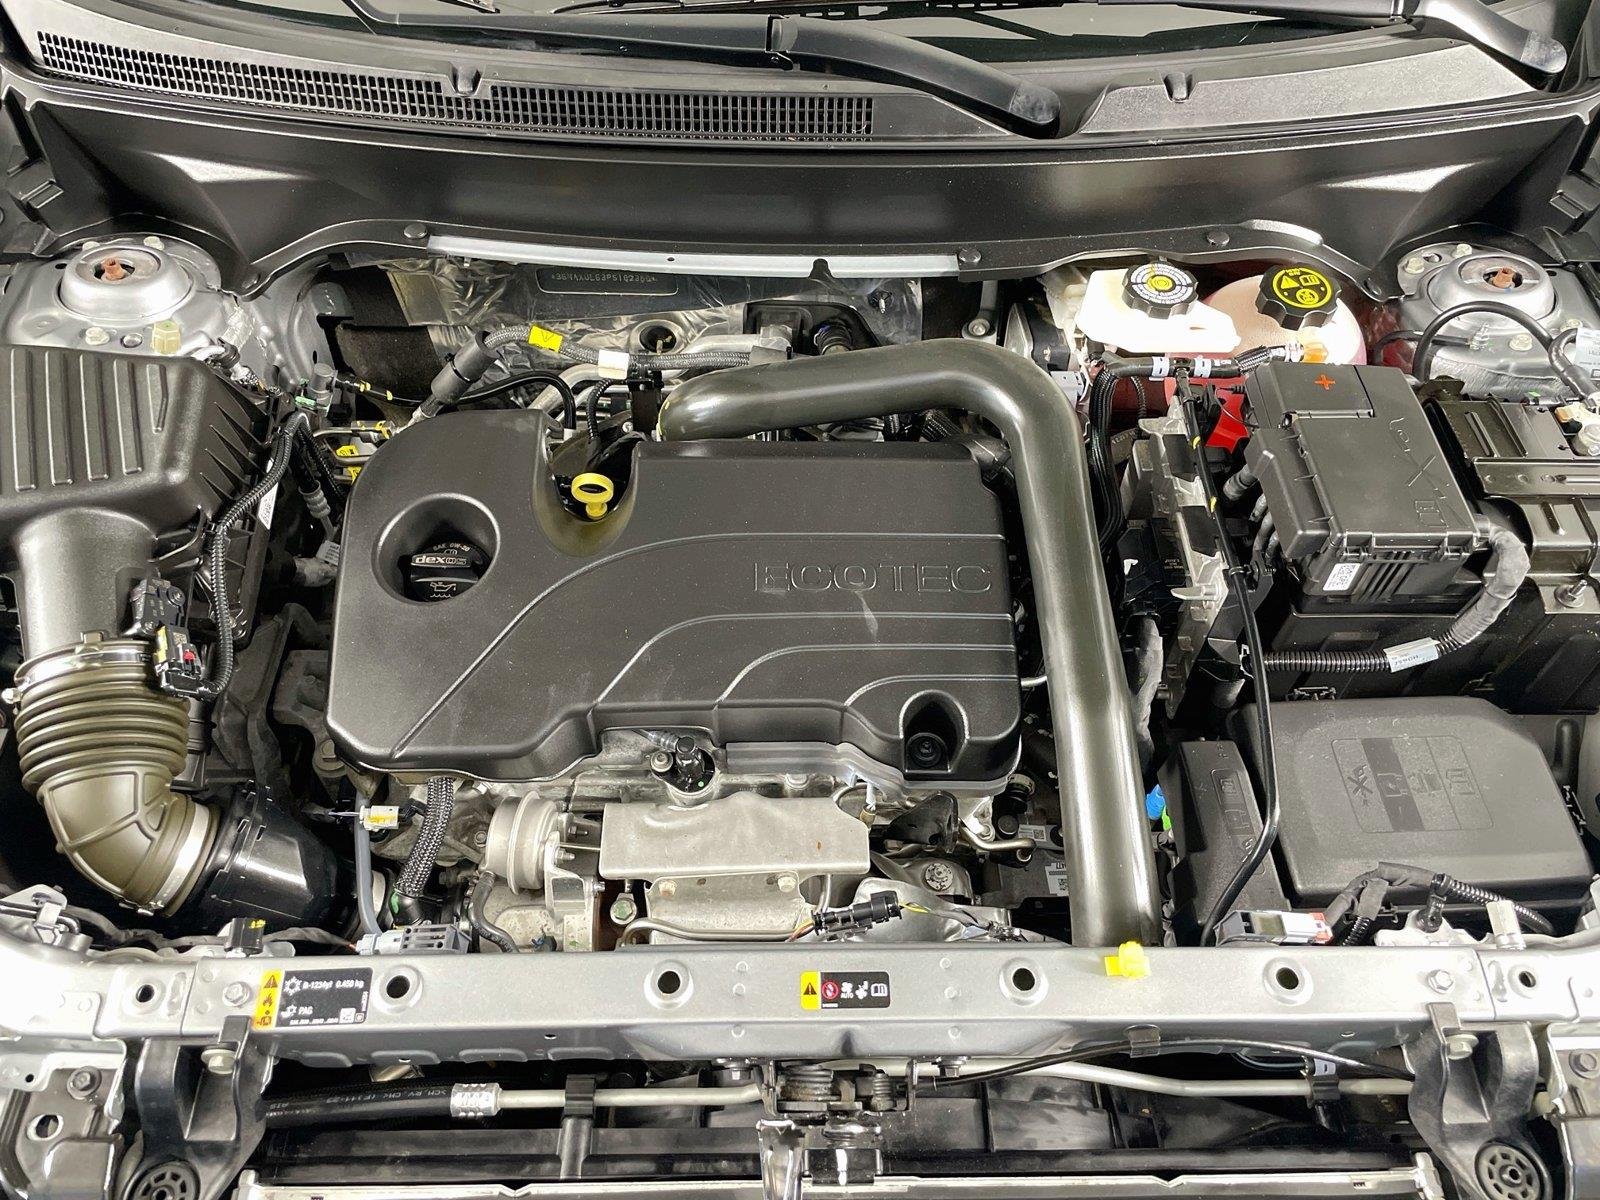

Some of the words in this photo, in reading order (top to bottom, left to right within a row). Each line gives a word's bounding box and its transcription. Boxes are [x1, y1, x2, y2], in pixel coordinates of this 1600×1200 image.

[415, 555, 466, 565] dexos
[754, 562, 991, 592] ECOTEC
[298, 1006, 313, 1014] PAG
